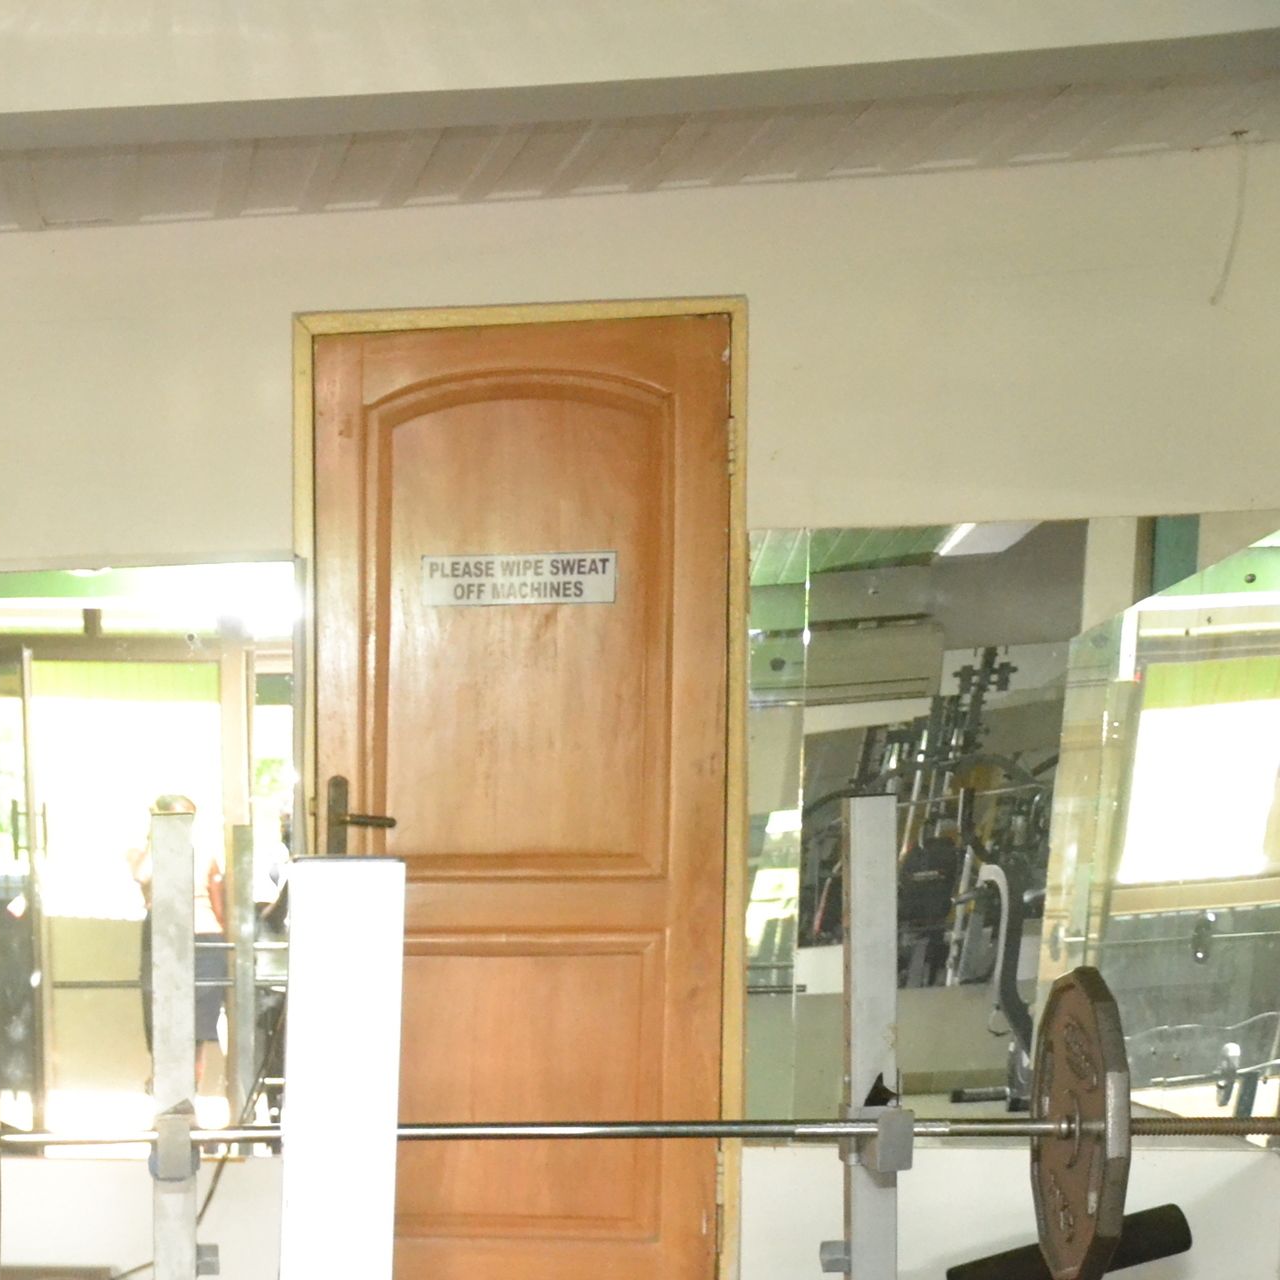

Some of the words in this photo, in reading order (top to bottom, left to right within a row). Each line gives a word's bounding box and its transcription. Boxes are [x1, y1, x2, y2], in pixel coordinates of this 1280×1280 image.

[429, 560, 495, 578] PLEASE
[500, 559, 545, 577] WIPE
[549, 557, 610, 575] SWEAT
[453, 583, 486, 600] OFF
[492, 581, 584, 600] MACHINES
